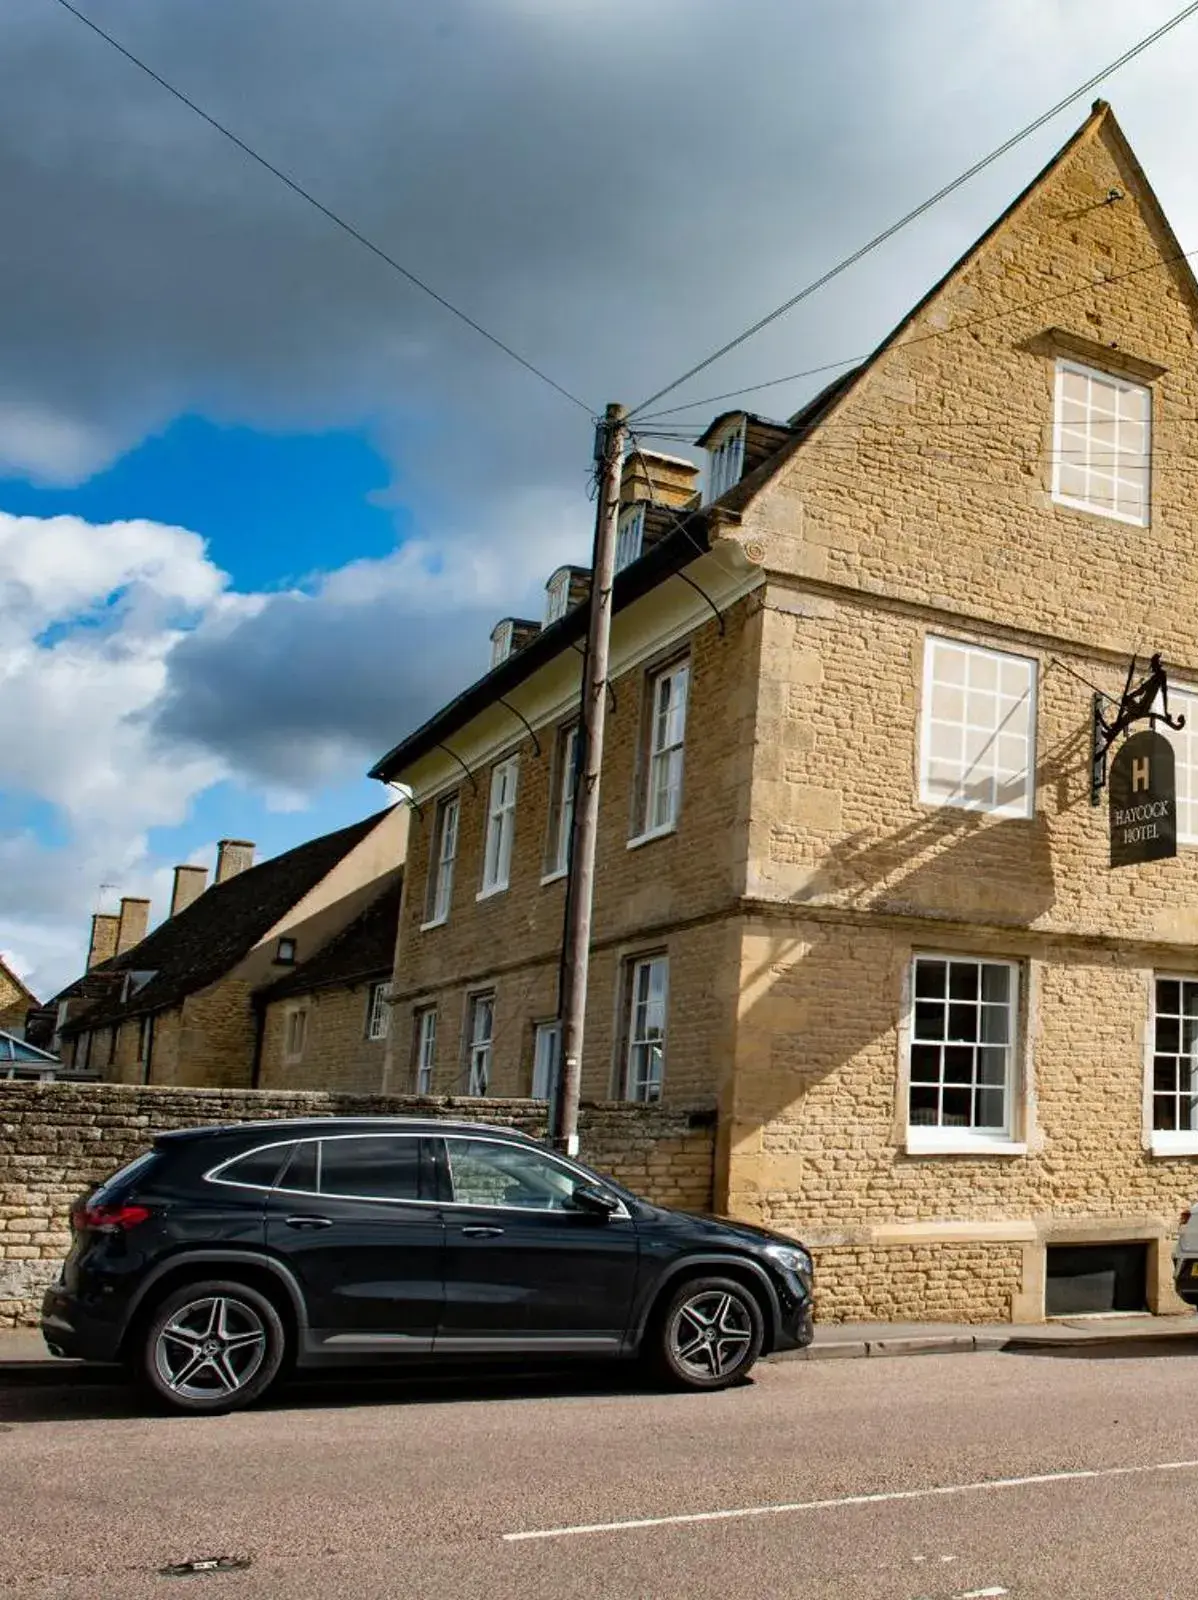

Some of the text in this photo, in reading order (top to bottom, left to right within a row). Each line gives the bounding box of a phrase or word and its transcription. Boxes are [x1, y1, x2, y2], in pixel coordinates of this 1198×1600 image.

[1132, 756, 1150, 793] H
[1115, 800, 1169, 826] HAYCOCK
[1123, 823, 1160, 845] HOTEL
